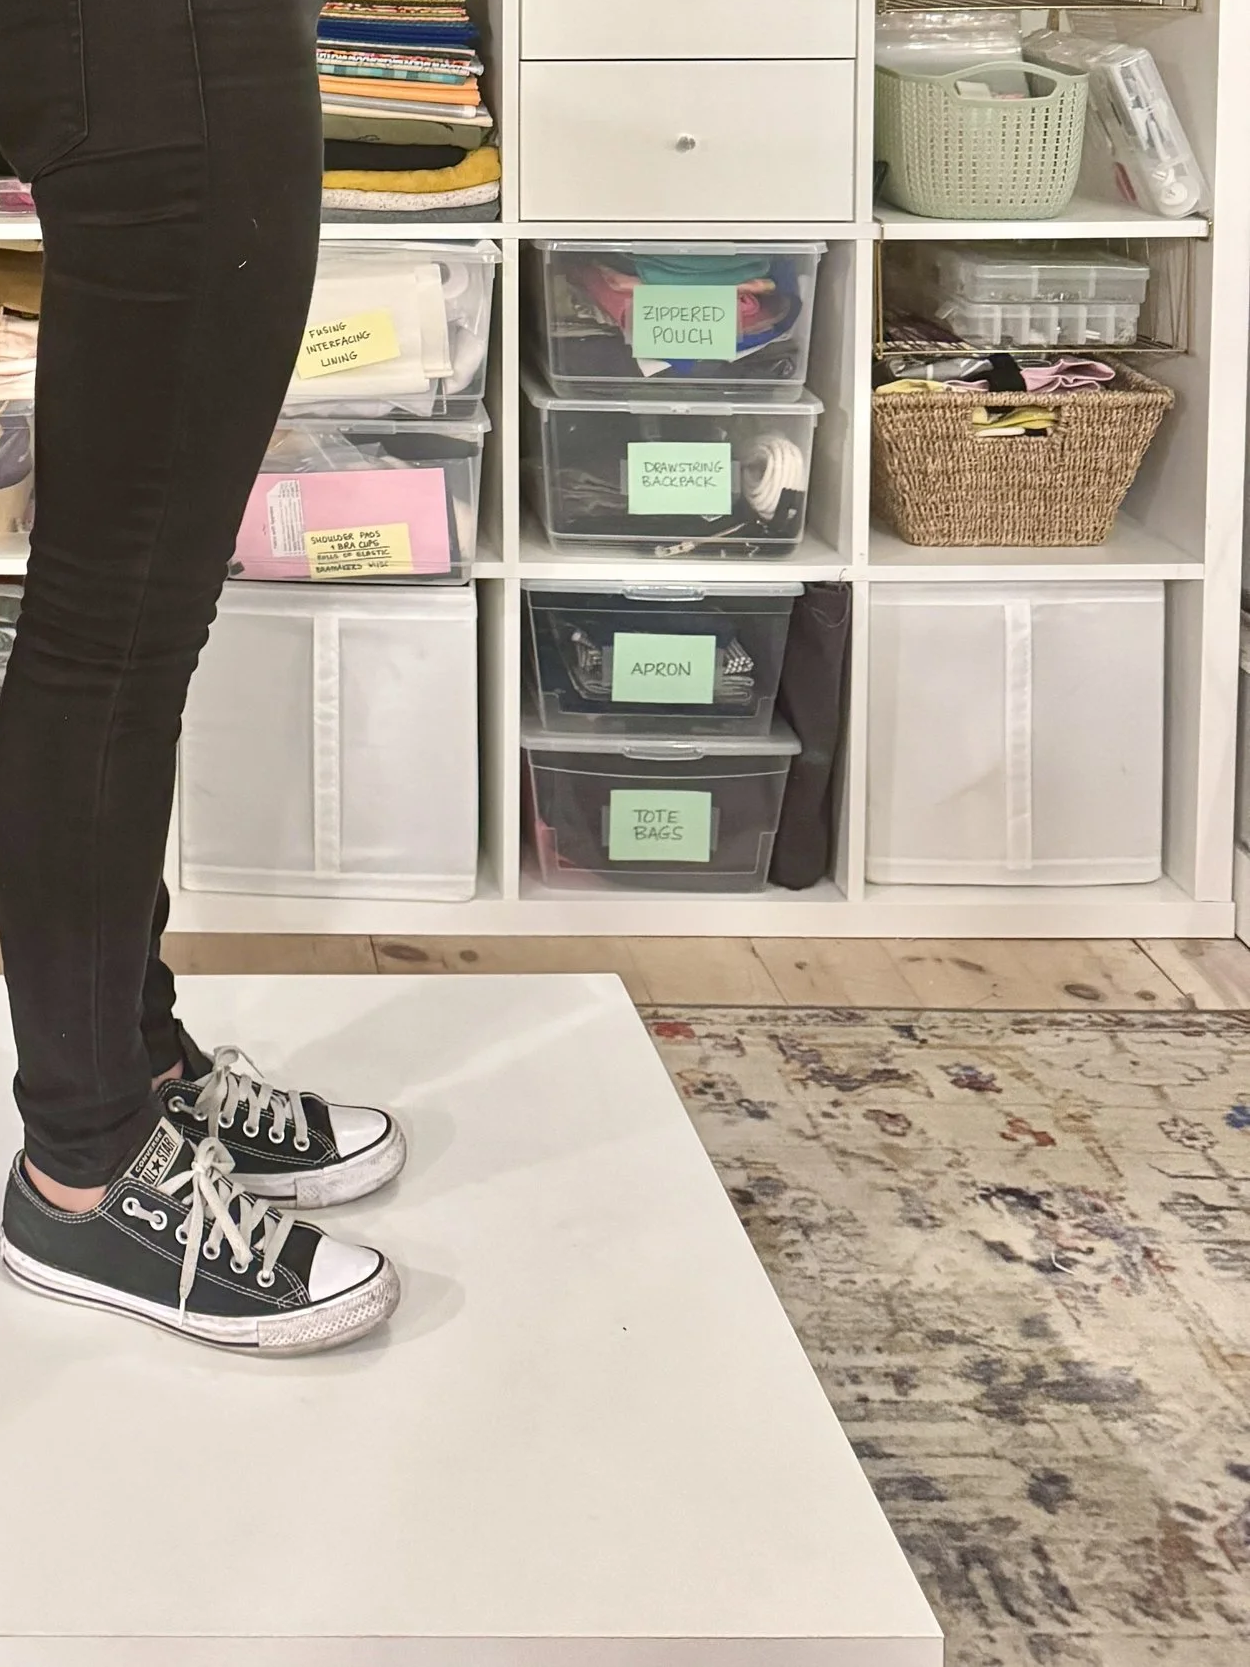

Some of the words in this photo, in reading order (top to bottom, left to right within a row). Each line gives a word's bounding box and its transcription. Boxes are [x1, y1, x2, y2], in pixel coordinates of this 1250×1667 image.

[642, 306, 725, 322] ZIPPERED
[309, 322, 347, 338] FUSING
[653, 326, 713, 345] POUCH
[306, 331, 371, 354] INTERFACING
[321, 351, 358, 367] LINING
[643, 460, 724, 474] DRAWSTRING
[642, 475, 717, 487] BACKPACK
[311, 533, 354, 544] SHOULDER
[359, 530, 381, 539] PADS
[338, 542, 356, 550] BRA
[359, 540, 380, 549] CUPS
[356, 549, 390, 558] ELASTIC
[631, 661, 691, 677] APRON
[632, 809, 680, 823] TOTE
[633, 825, 684, 841] BAGS
[134, 1131, 163, 1173] CONVERSE
[156, 1136, 176, 1163] STAR
